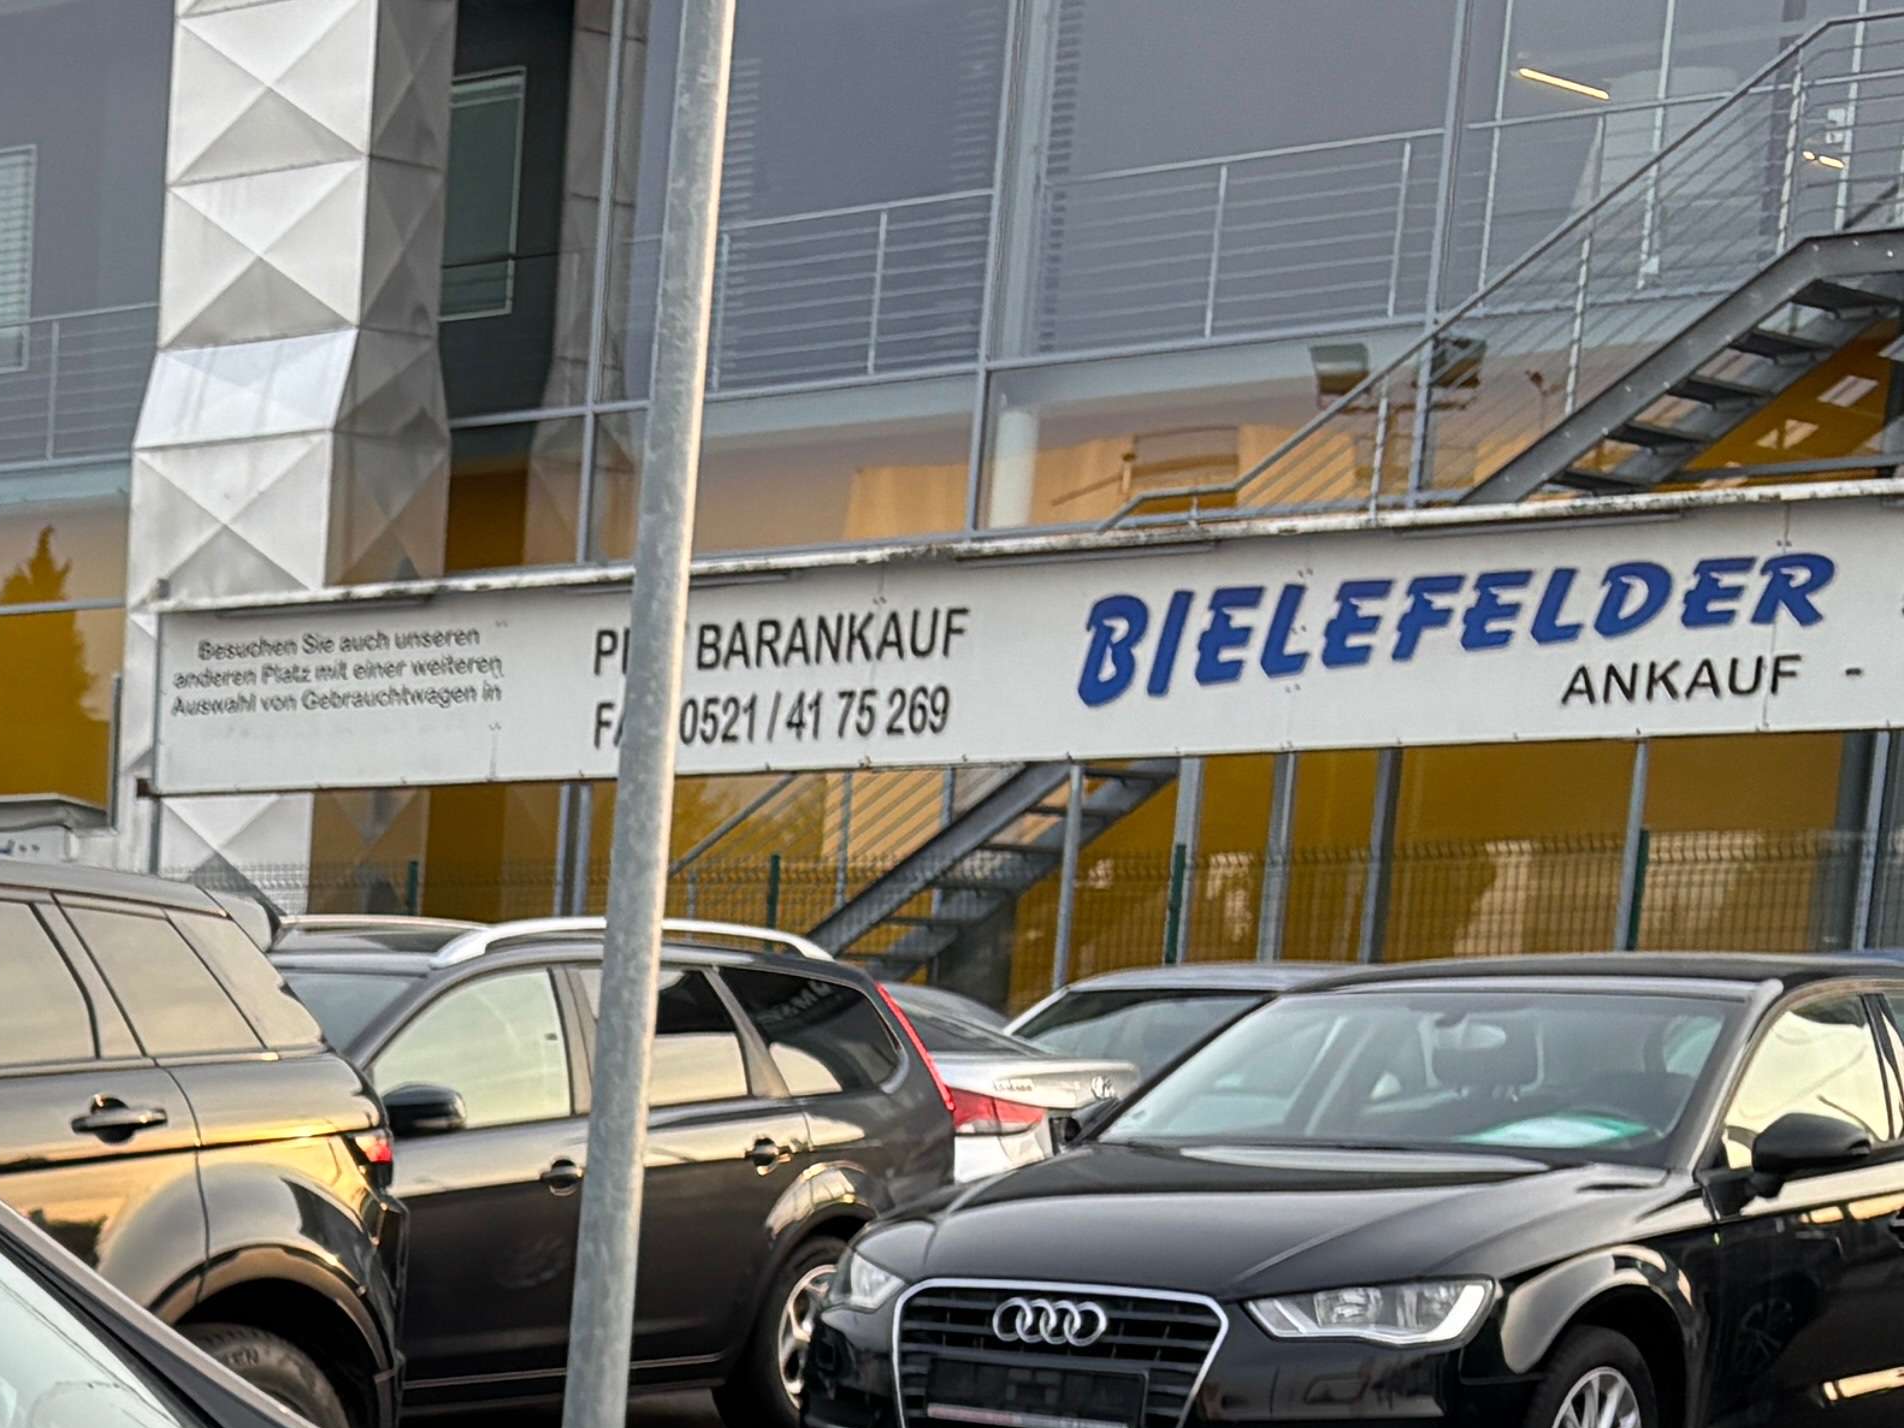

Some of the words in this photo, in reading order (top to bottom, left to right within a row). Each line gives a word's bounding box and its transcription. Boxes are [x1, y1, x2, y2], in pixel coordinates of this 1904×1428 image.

[198, 636, 298, 661] Besuchen
[302, 633, 336, 655] Sie
[340, 629, 390, 652] auch
[395, 627, 481, 650] unseren
[697, 607, 970, 671] BARANKAUF
[1077, 552, 1836, 708] BIELEFELDER
[173, 669, 257, 689] anderen
[261, 663, 312, 686] Platz
[315, 660, 348, 682] mit
[353, 659, 406, 681] einer
[412, 655, 504, 678] weiteren
[1561, 654, 1803, 706] ANKAUF
[172, 694, 257, 717] Auswahl
[261, 695, 297, 713] von
[301, 684, 478, 710] Gebrauchtwagen
[482, 681, 502, 702] in
[838, 687, 877, 739] 75
[886, 684, 951, 736] 269
